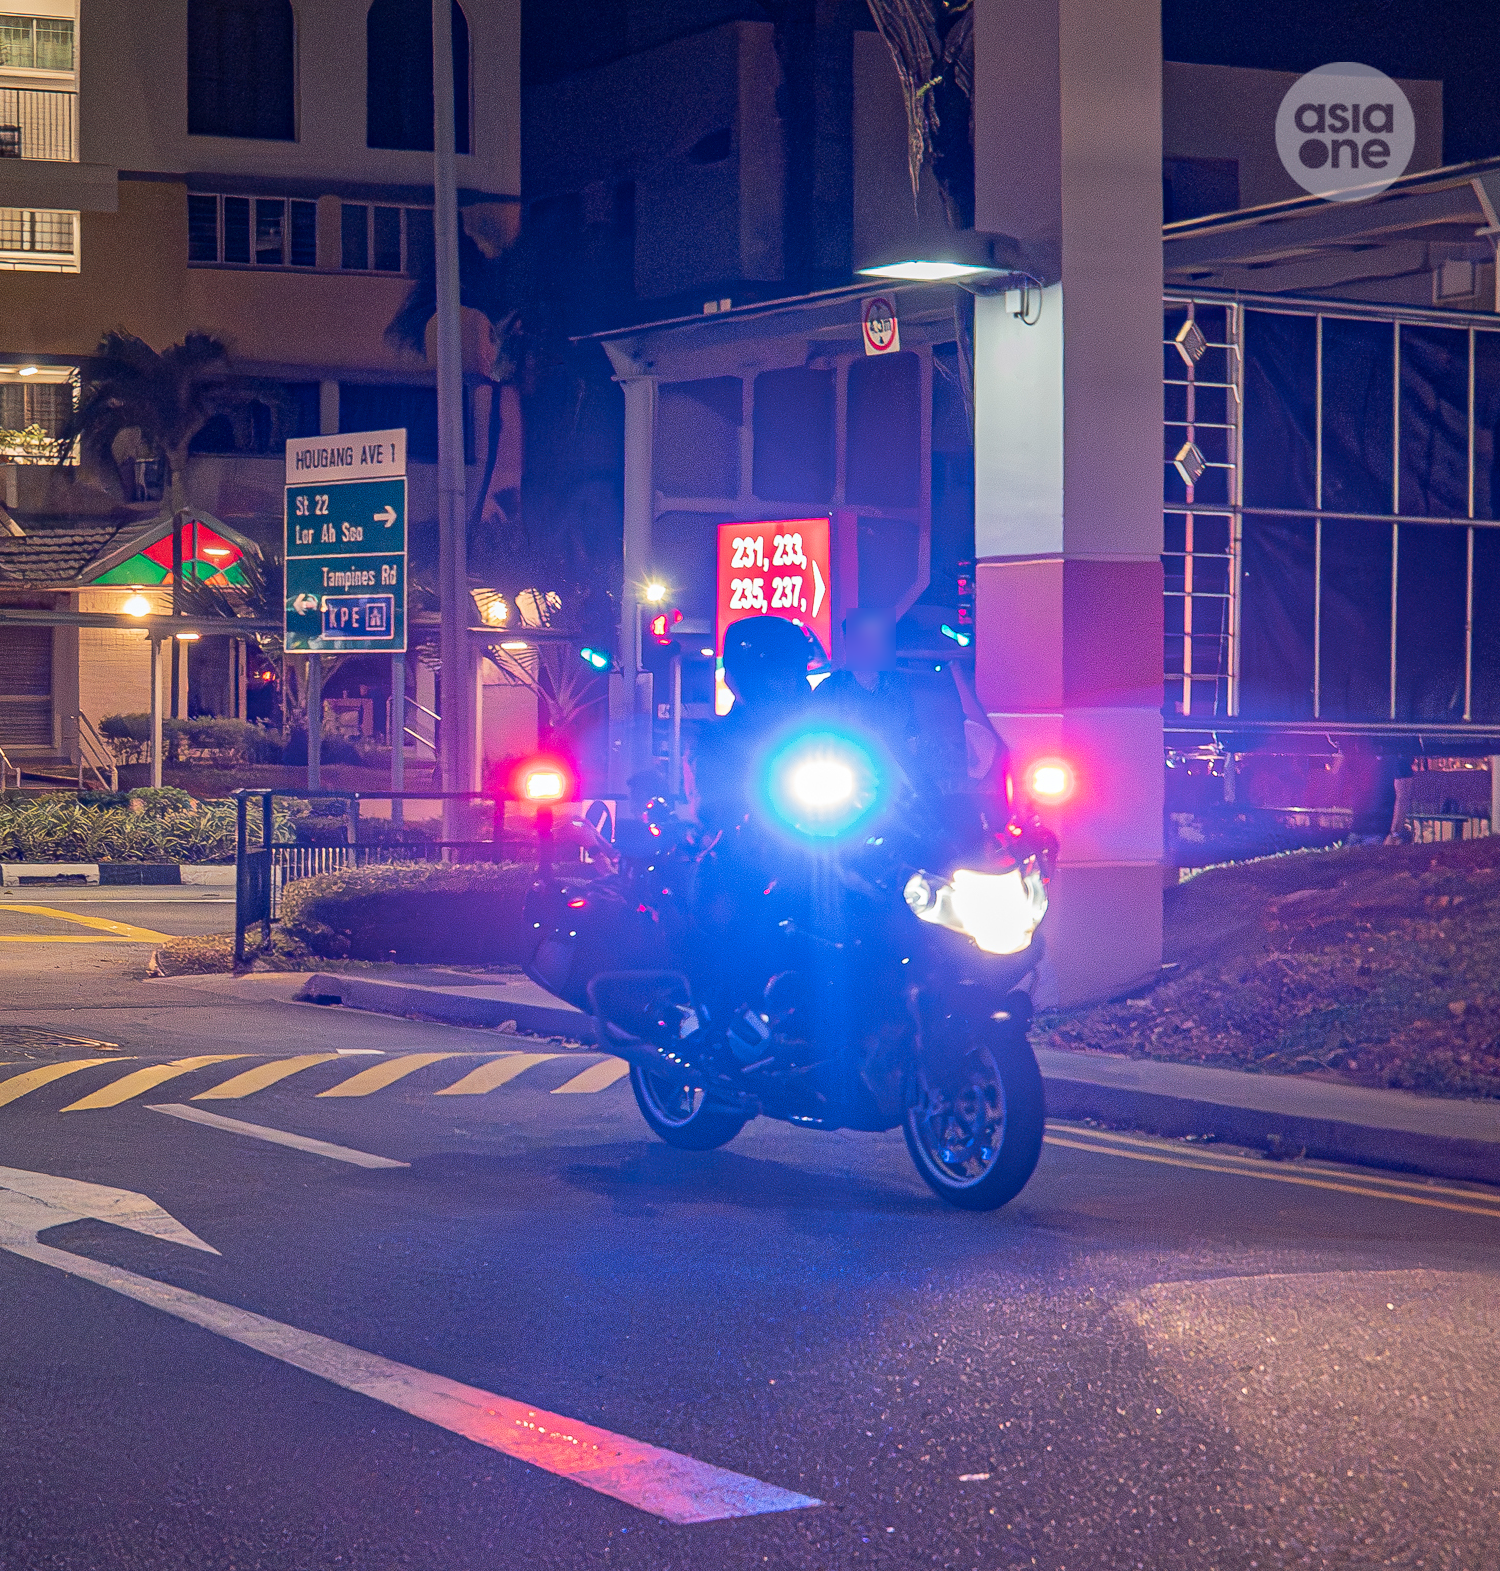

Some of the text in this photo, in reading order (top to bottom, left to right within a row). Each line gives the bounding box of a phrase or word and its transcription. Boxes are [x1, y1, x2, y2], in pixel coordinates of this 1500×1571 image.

[295, 443, 396, 470] HOUGANG AVE 1
[295, 494, 329, 516] St 22
[295, 522, 363, 545] Lor Ah Soo
[731, 533, 807, 572] 231, 233,
[321, 564, 397, 592] Tampines Rd
[729, 576, 807, 614] 235, 237,
[329, 605, 360, 628] KPE
